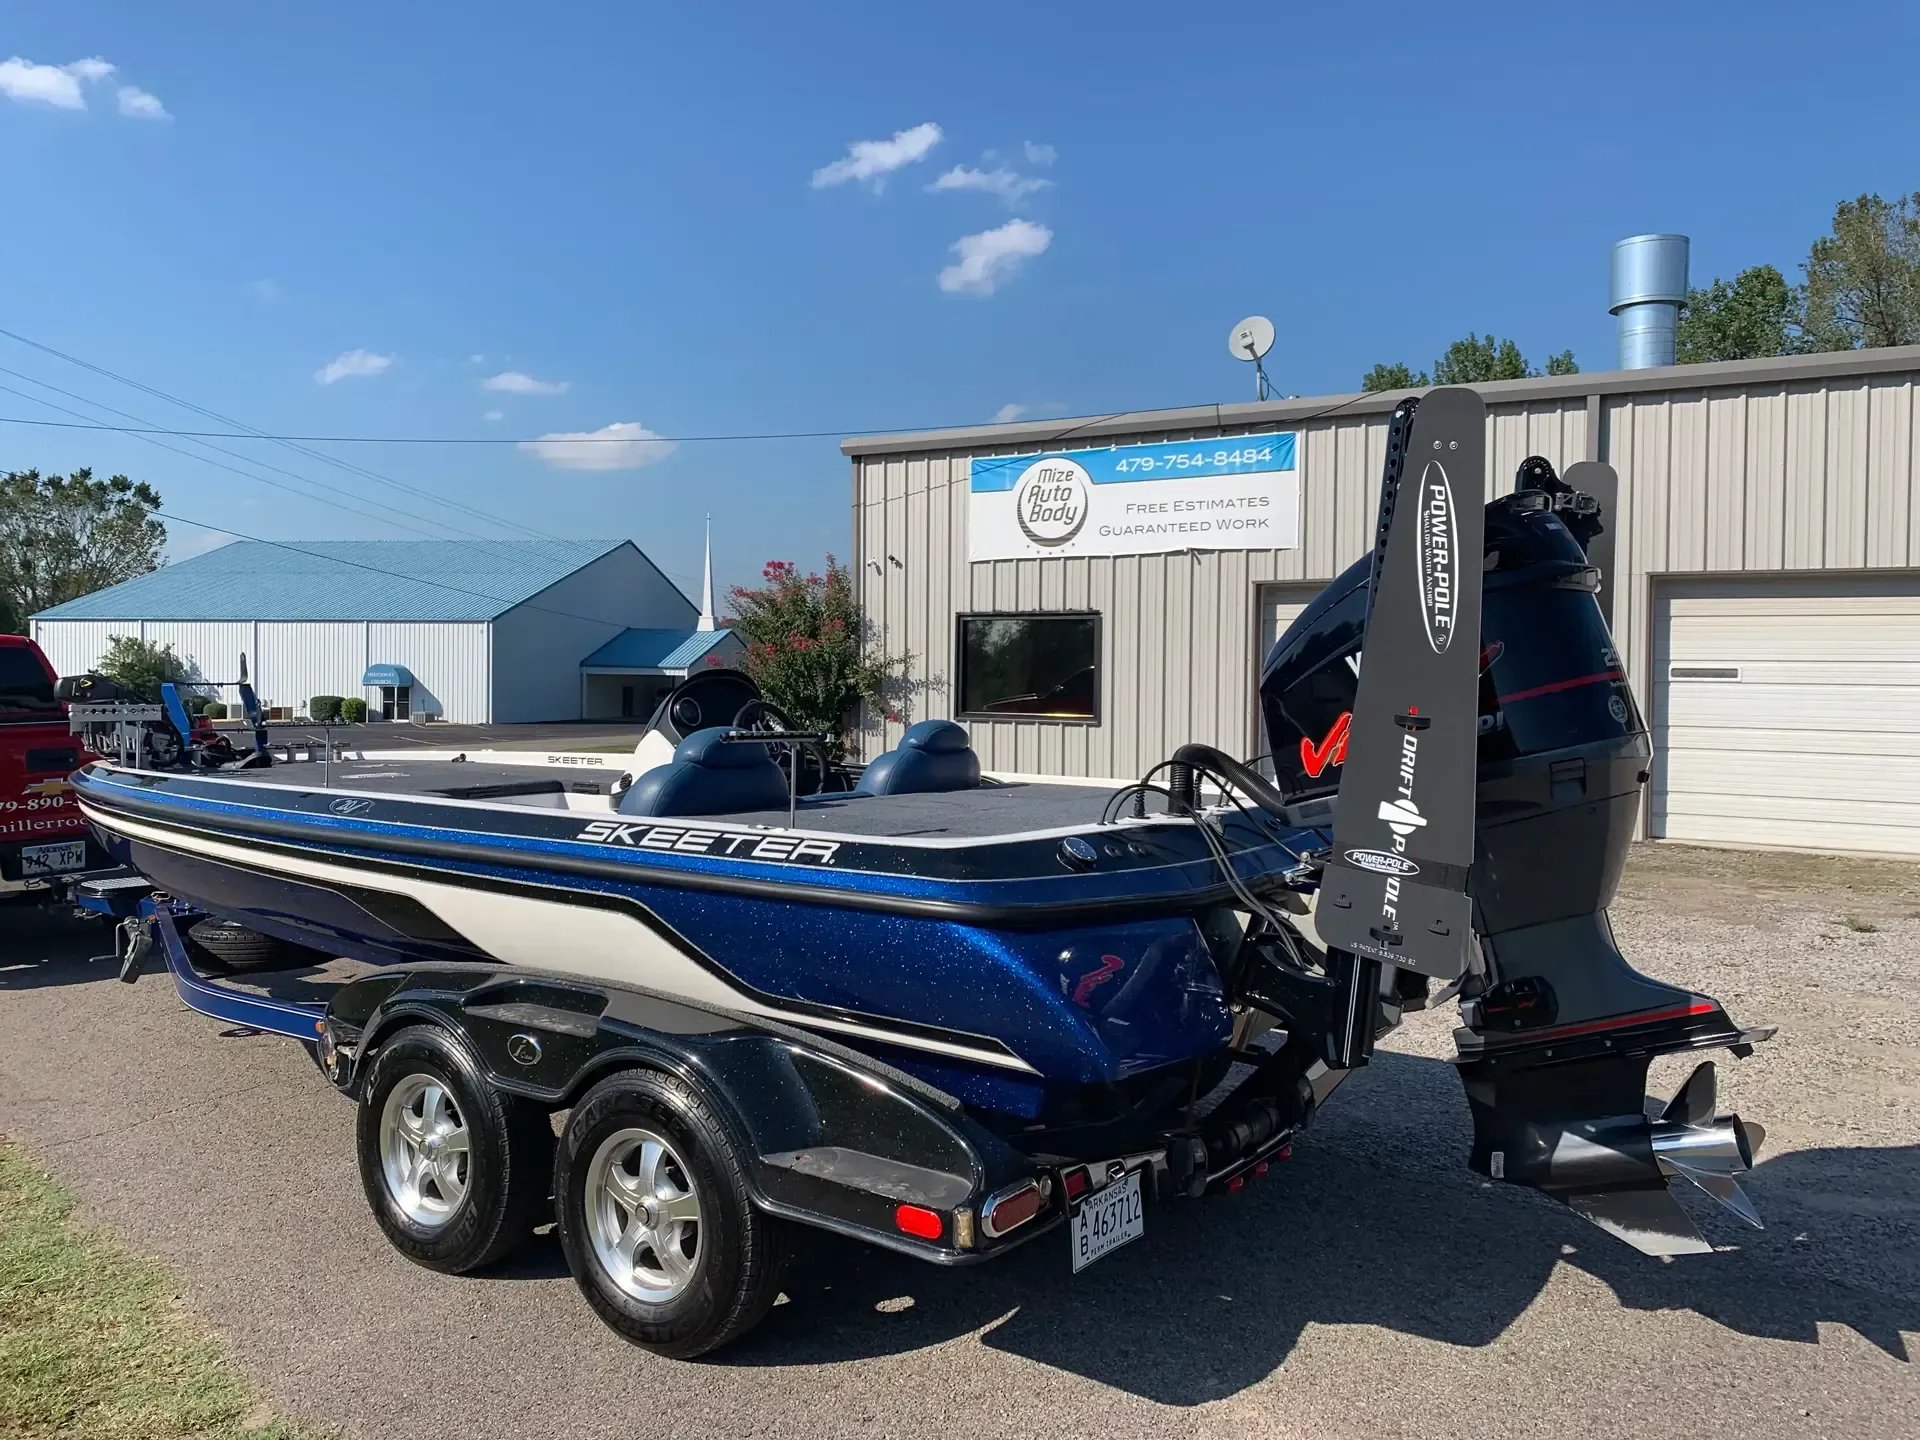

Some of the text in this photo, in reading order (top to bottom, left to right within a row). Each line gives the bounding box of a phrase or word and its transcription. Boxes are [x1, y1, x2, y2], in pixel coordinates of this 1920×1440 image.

[1115, 447, 1272, 473] 479-754-8484
[1037, 468, 1074, 483] Mize
[1028, 485, 1072, 503] Auto
[1029, 502, 1078, 525] Body
[1126, 497, 1270, 514] FREE ESTIMATES
[1099, 518, 1270, 537] GUARANTEED WORK
[1430, 485, 1450, 629] POWER-POLE
[548, 756, 604, 765] SKEETER
[1398, 734, 1417, 799] DRIFT
[576, 821, 840, 864] SKEETER
[60, 850, 82, 866] XPW
[1353, 852, 1409, 871] POWER-POLE
[1088, 1183, 1128, 1212] ARKANSAS
[1093, 1190, 1140, 1240] 463712
